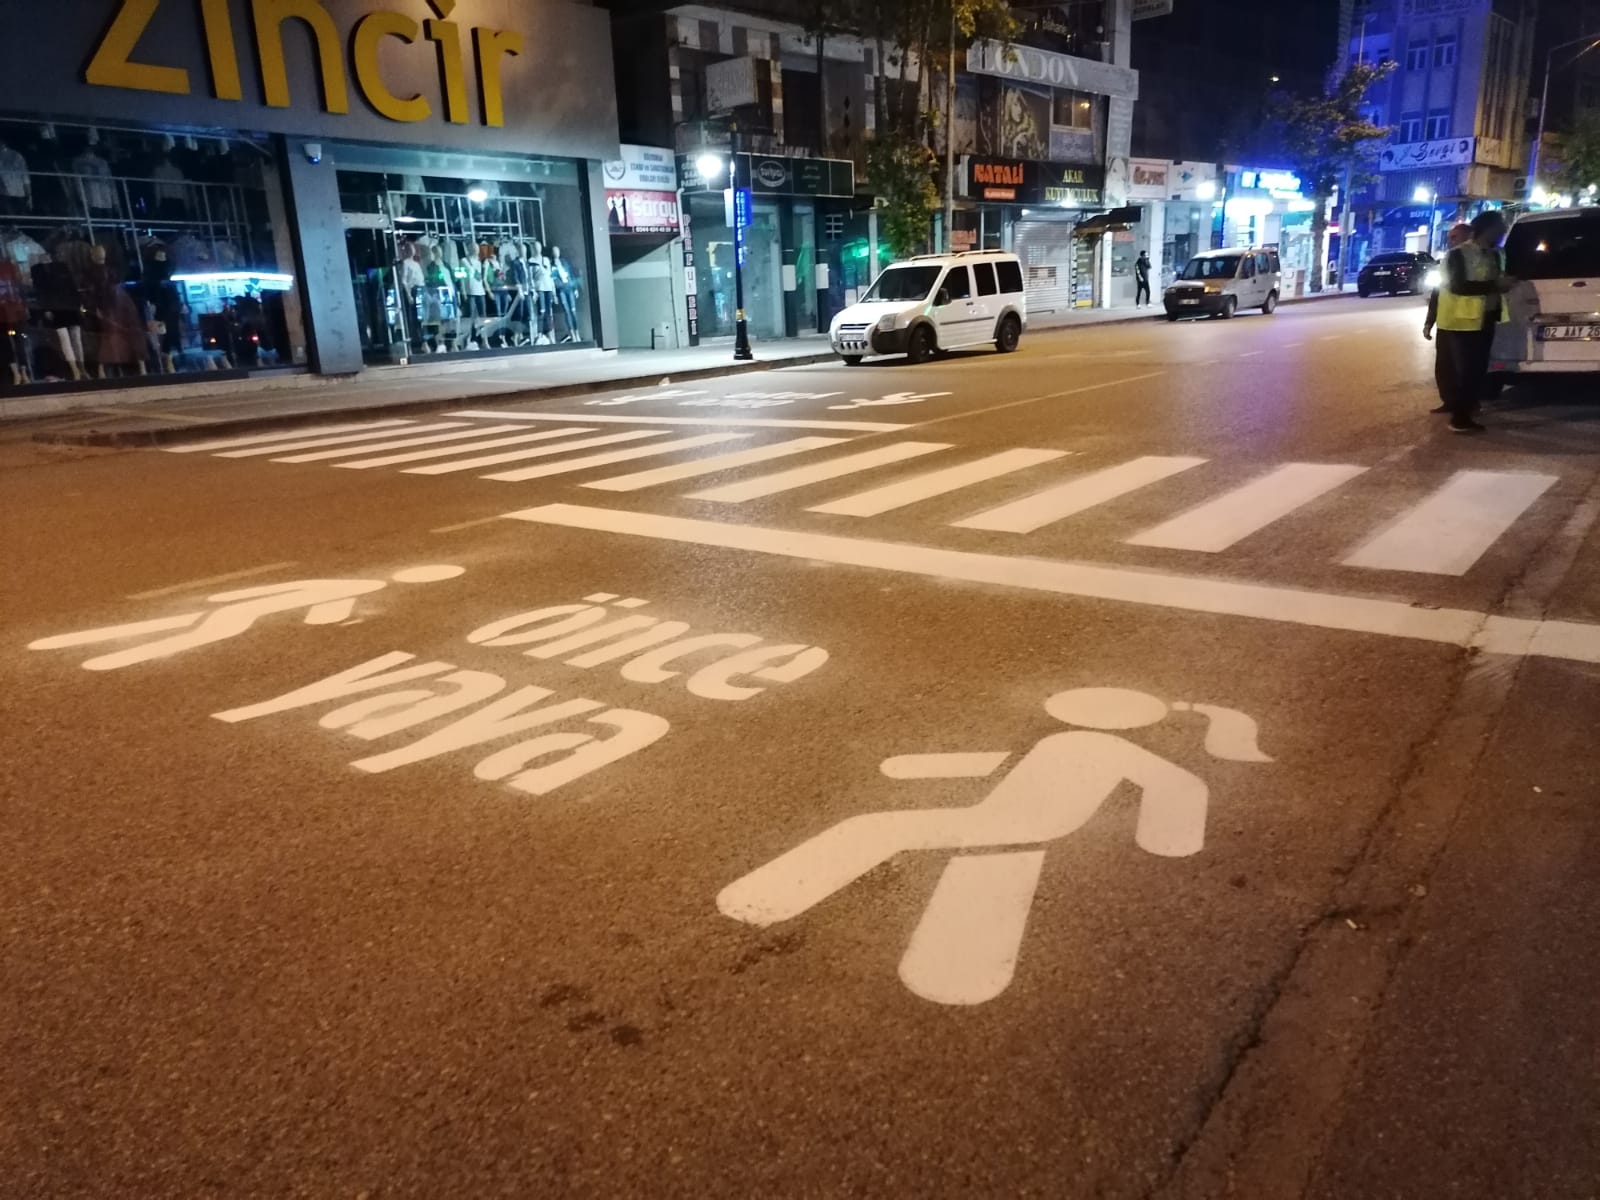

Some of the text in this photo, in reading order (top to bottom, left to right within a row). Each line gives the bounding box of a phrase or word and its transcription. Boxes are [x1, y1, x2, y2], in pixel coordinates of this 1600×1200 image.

[86, 0, 525, 127] zincir
[981, 45, 1079, 87] LONDON
[1062, 169, 1084, 183] AKAR
